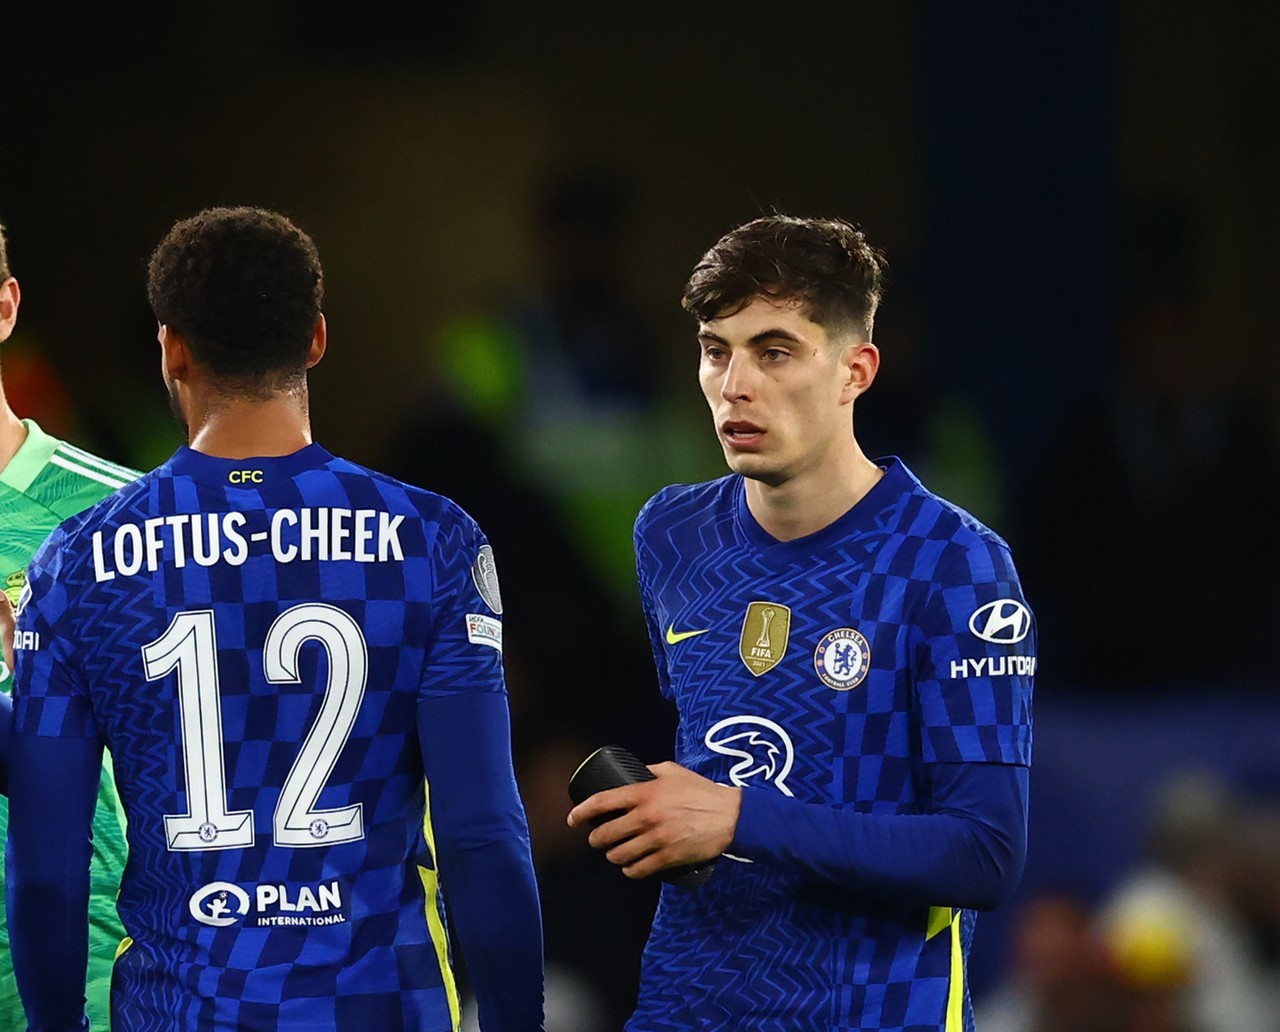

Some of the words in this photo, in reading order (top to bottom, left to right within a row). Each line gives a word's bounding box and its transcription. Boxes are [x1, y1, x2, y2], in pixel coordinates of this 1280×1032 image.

[228, 470, 263, 484] CFC
[92, 507, 405, 583] LOFTUS-CHEEK
[828, 630, 864, 647] CHELSEA
[750, 647, 772, 658] FIFA
[950, 655, 1036, 679] HYUNDAI
[141, 602, 369, 852] 12
[256, 881, 342, 912] PLAN
[257, 913, 346, 926] INTERNATIONAL
